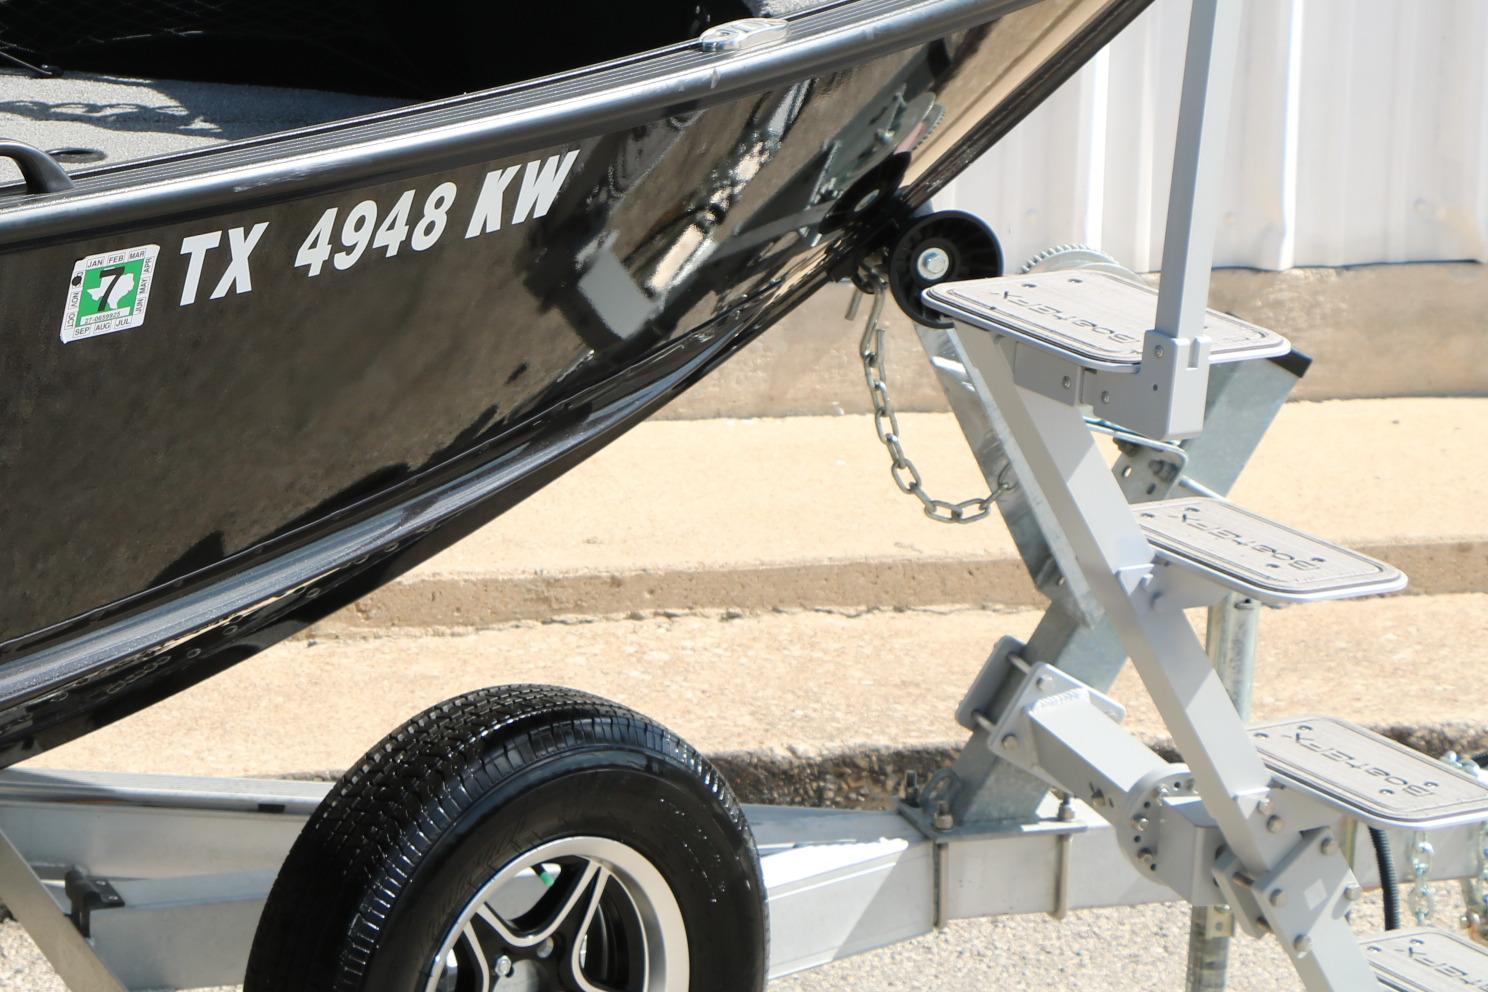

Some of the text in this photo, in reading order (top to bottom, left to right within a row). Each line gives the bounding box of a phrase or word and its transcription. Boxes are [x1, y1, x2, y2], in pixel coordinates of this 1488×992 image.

[179, 149, 580, 306] TX 4948 KW
[87, 250, 145, 268] JAN FEB MAR
[97, 266, 126, 312] 7
[136, 298, 144, 313] JUN
[144, 257, 152, 273] APR
[71, 291, 79, 307] NOV
[68, 313, 76, 327] OCT
[75, 318, 131, 336] SEP AUG JUL
